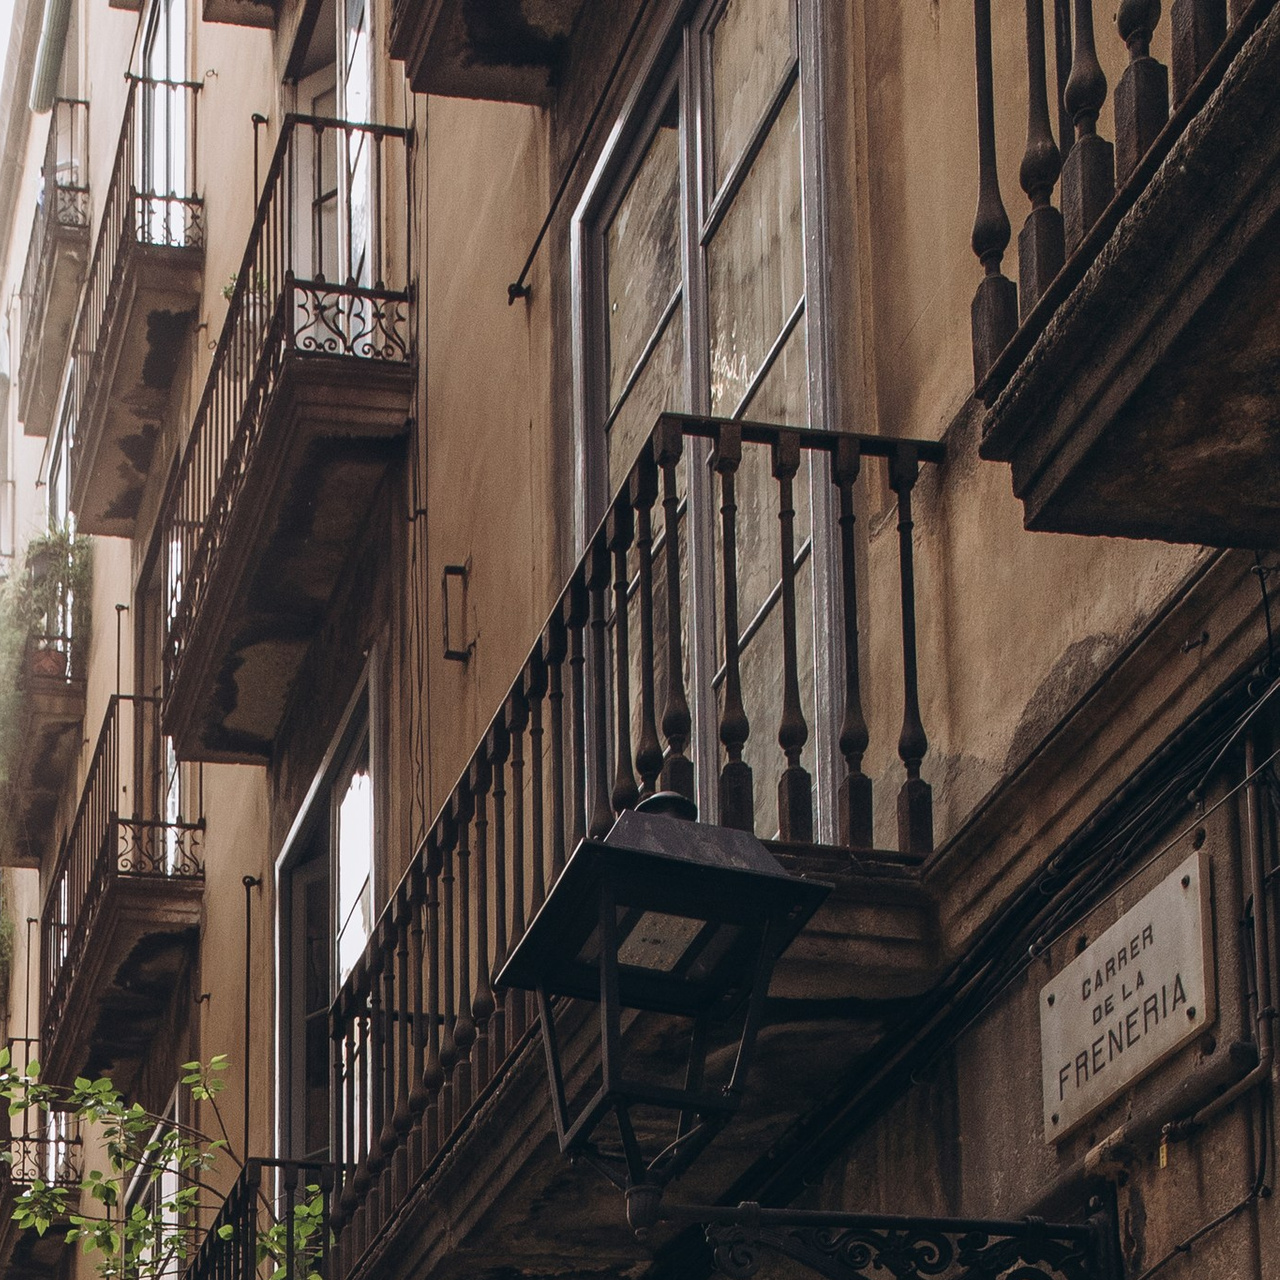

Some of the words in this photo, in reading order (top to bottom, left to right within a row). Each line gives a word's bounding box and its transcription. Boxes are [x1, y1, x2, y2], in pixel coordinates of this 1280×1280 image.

[1081, 924, 1155, 1001] CARRER
[1092, 994, 1115, 1026] DE
[1122, 970, 1145, 1000] LA
[1059, 973, 1187, 1101] FRENERIA
